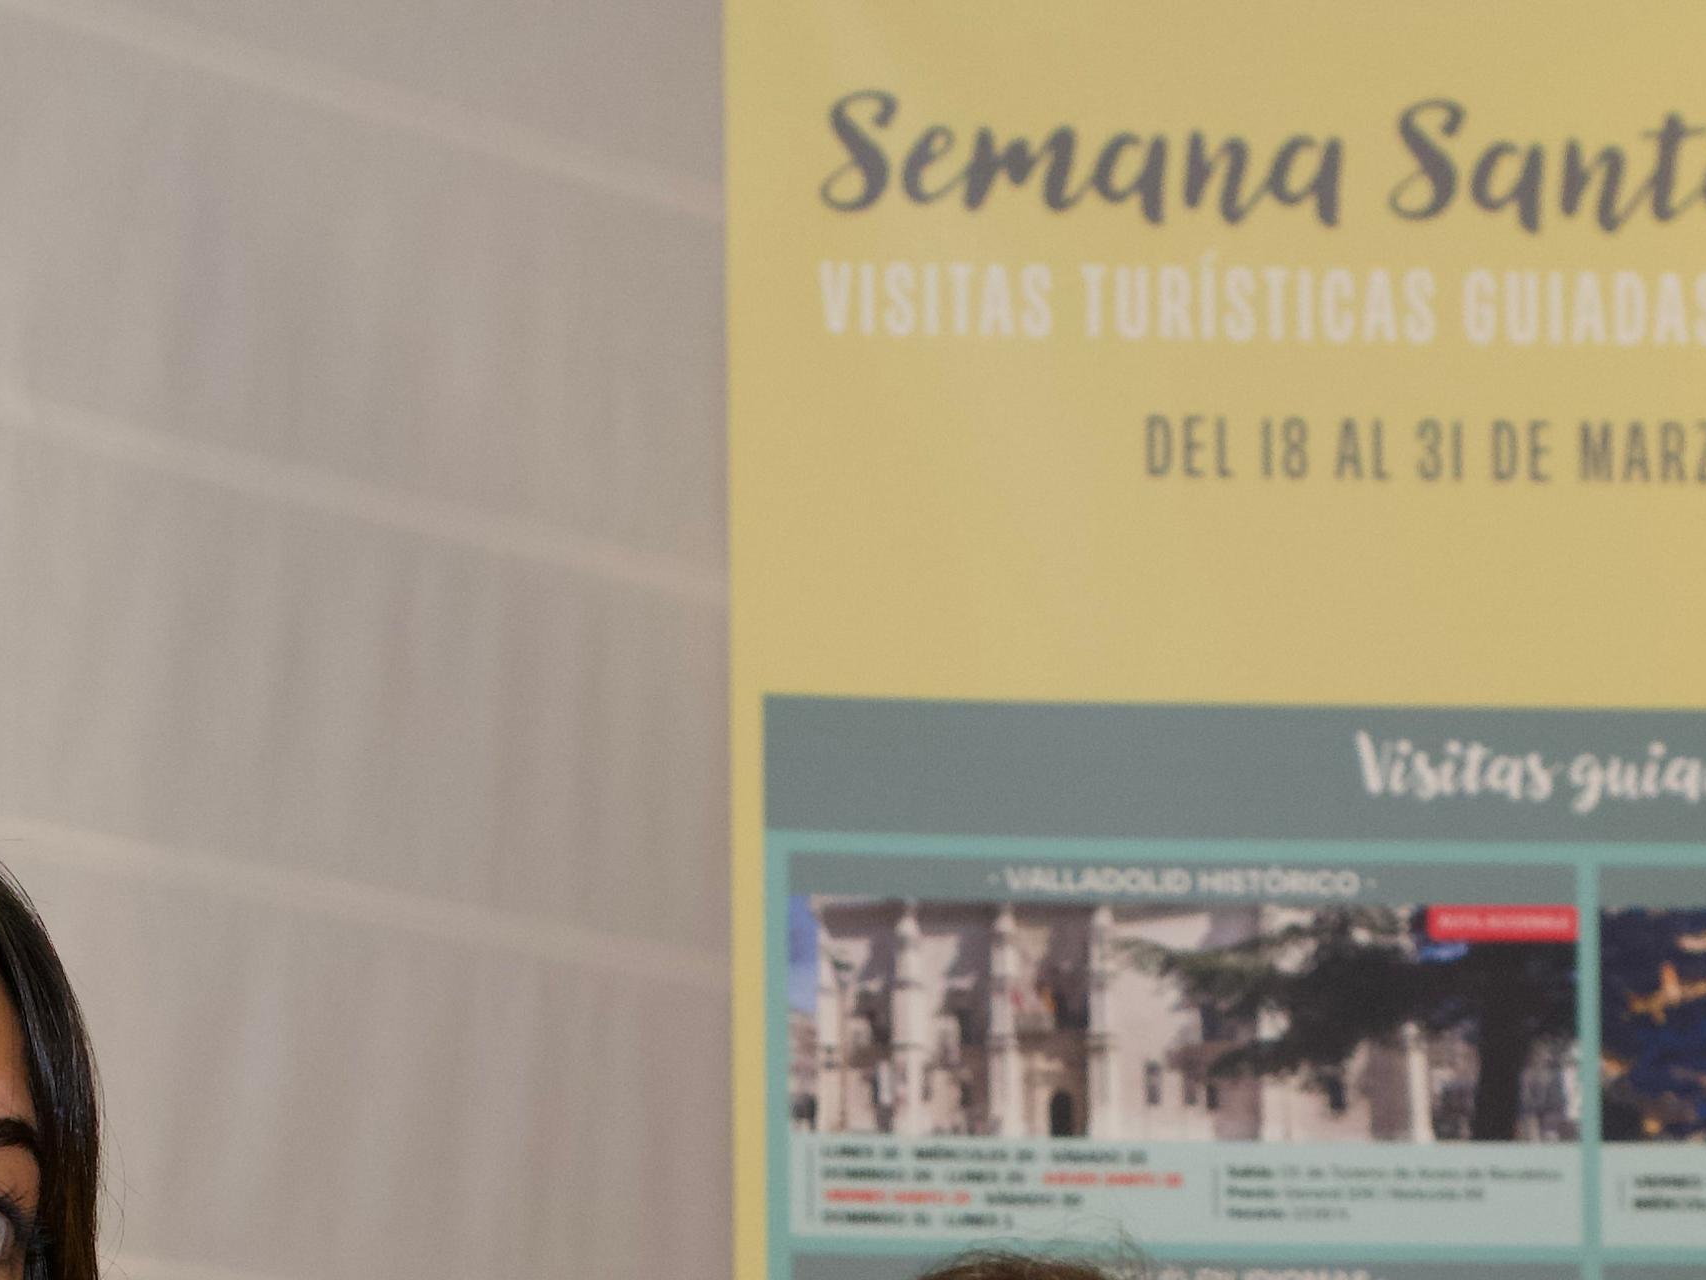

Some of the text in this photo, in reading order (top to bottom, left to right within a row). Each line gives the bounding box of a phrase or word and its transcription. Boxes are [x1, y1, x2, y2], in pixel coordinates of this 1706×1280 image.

[818, 89, 1345, 230] Semana
[818, 261, 1055, 338] VISITAS
[1082, 250, 1438, 346] TURÍSTICAS
[1145, 414, 1235, 480] DEL
[1261, 416, 1311, 481] 18
[1337, 418, 1391, 482] AL
[1417, 420, 1464, 484] 31
[1495, 421, 1552, 484] DE
[1356, 729, 1556, 802] Visitas
[1005, 867, 1191, 896] VALLADOLID
